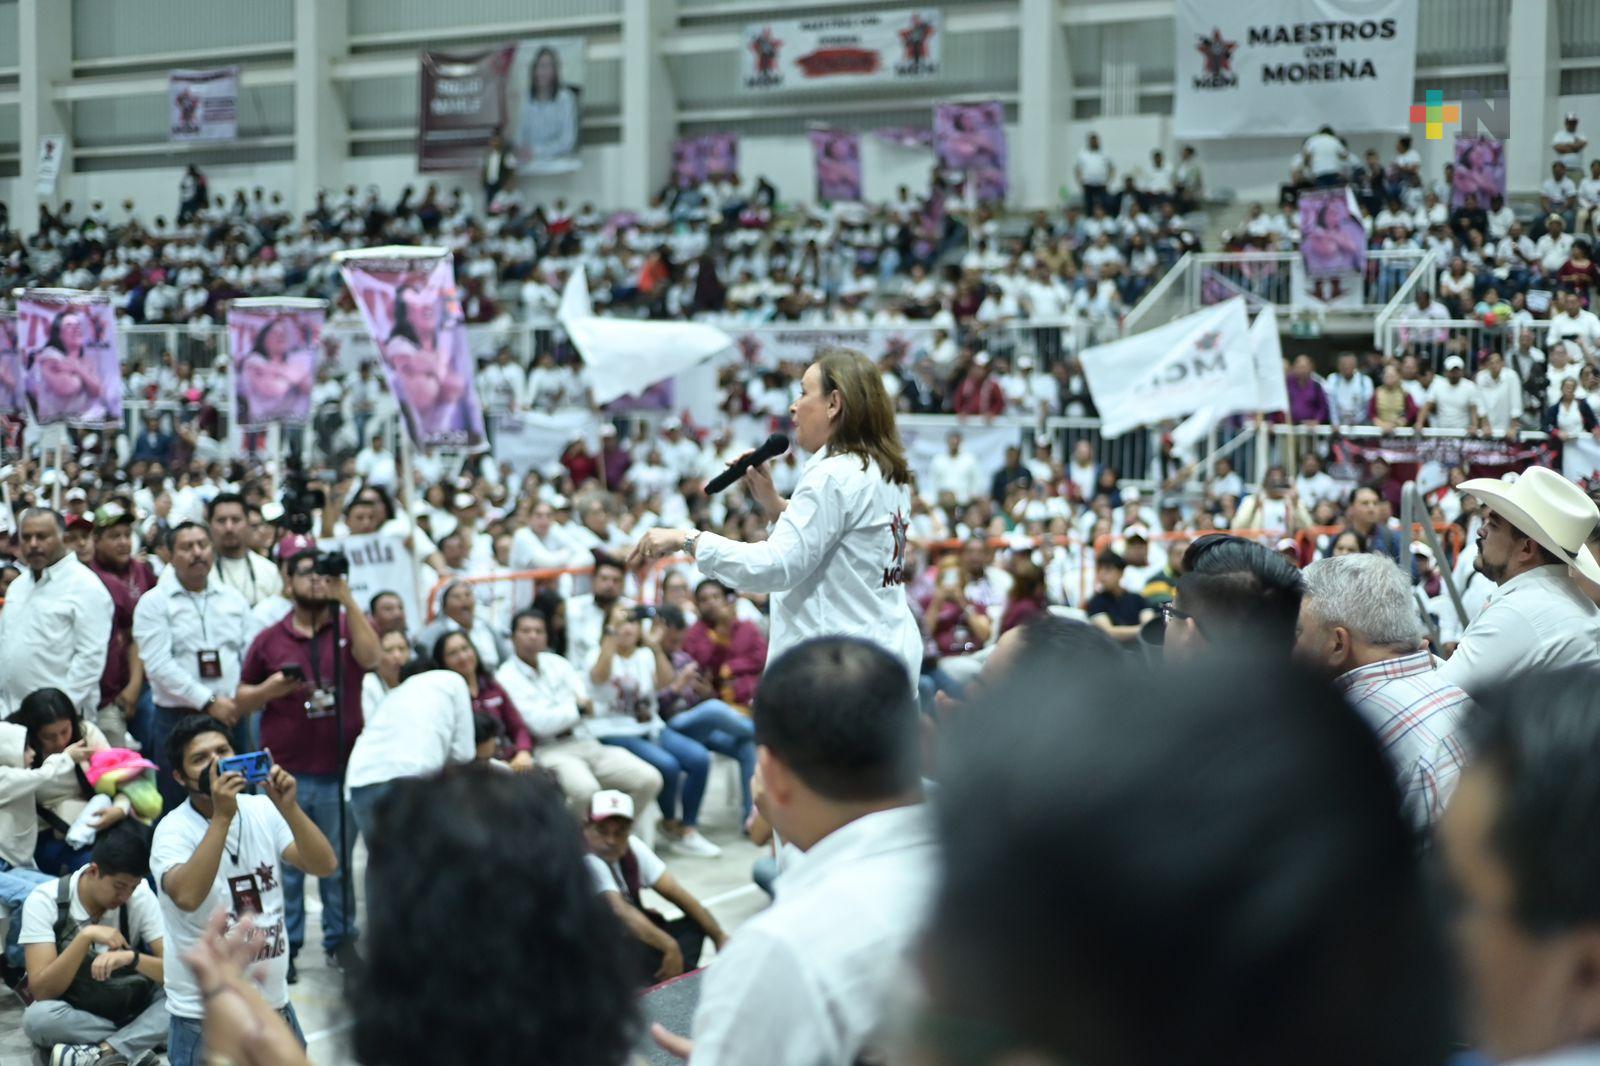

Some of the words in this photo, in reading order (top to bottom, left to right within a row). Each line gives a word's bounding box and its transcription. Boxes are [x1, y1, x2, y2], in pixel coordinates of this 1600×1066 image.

[1248, 18, 1397, 46] MAESTROS
[1303, 45, 1337, 59] CON
[1262, 59, 1377, 85] MORENA
[339, 539, 395, 566] utla
